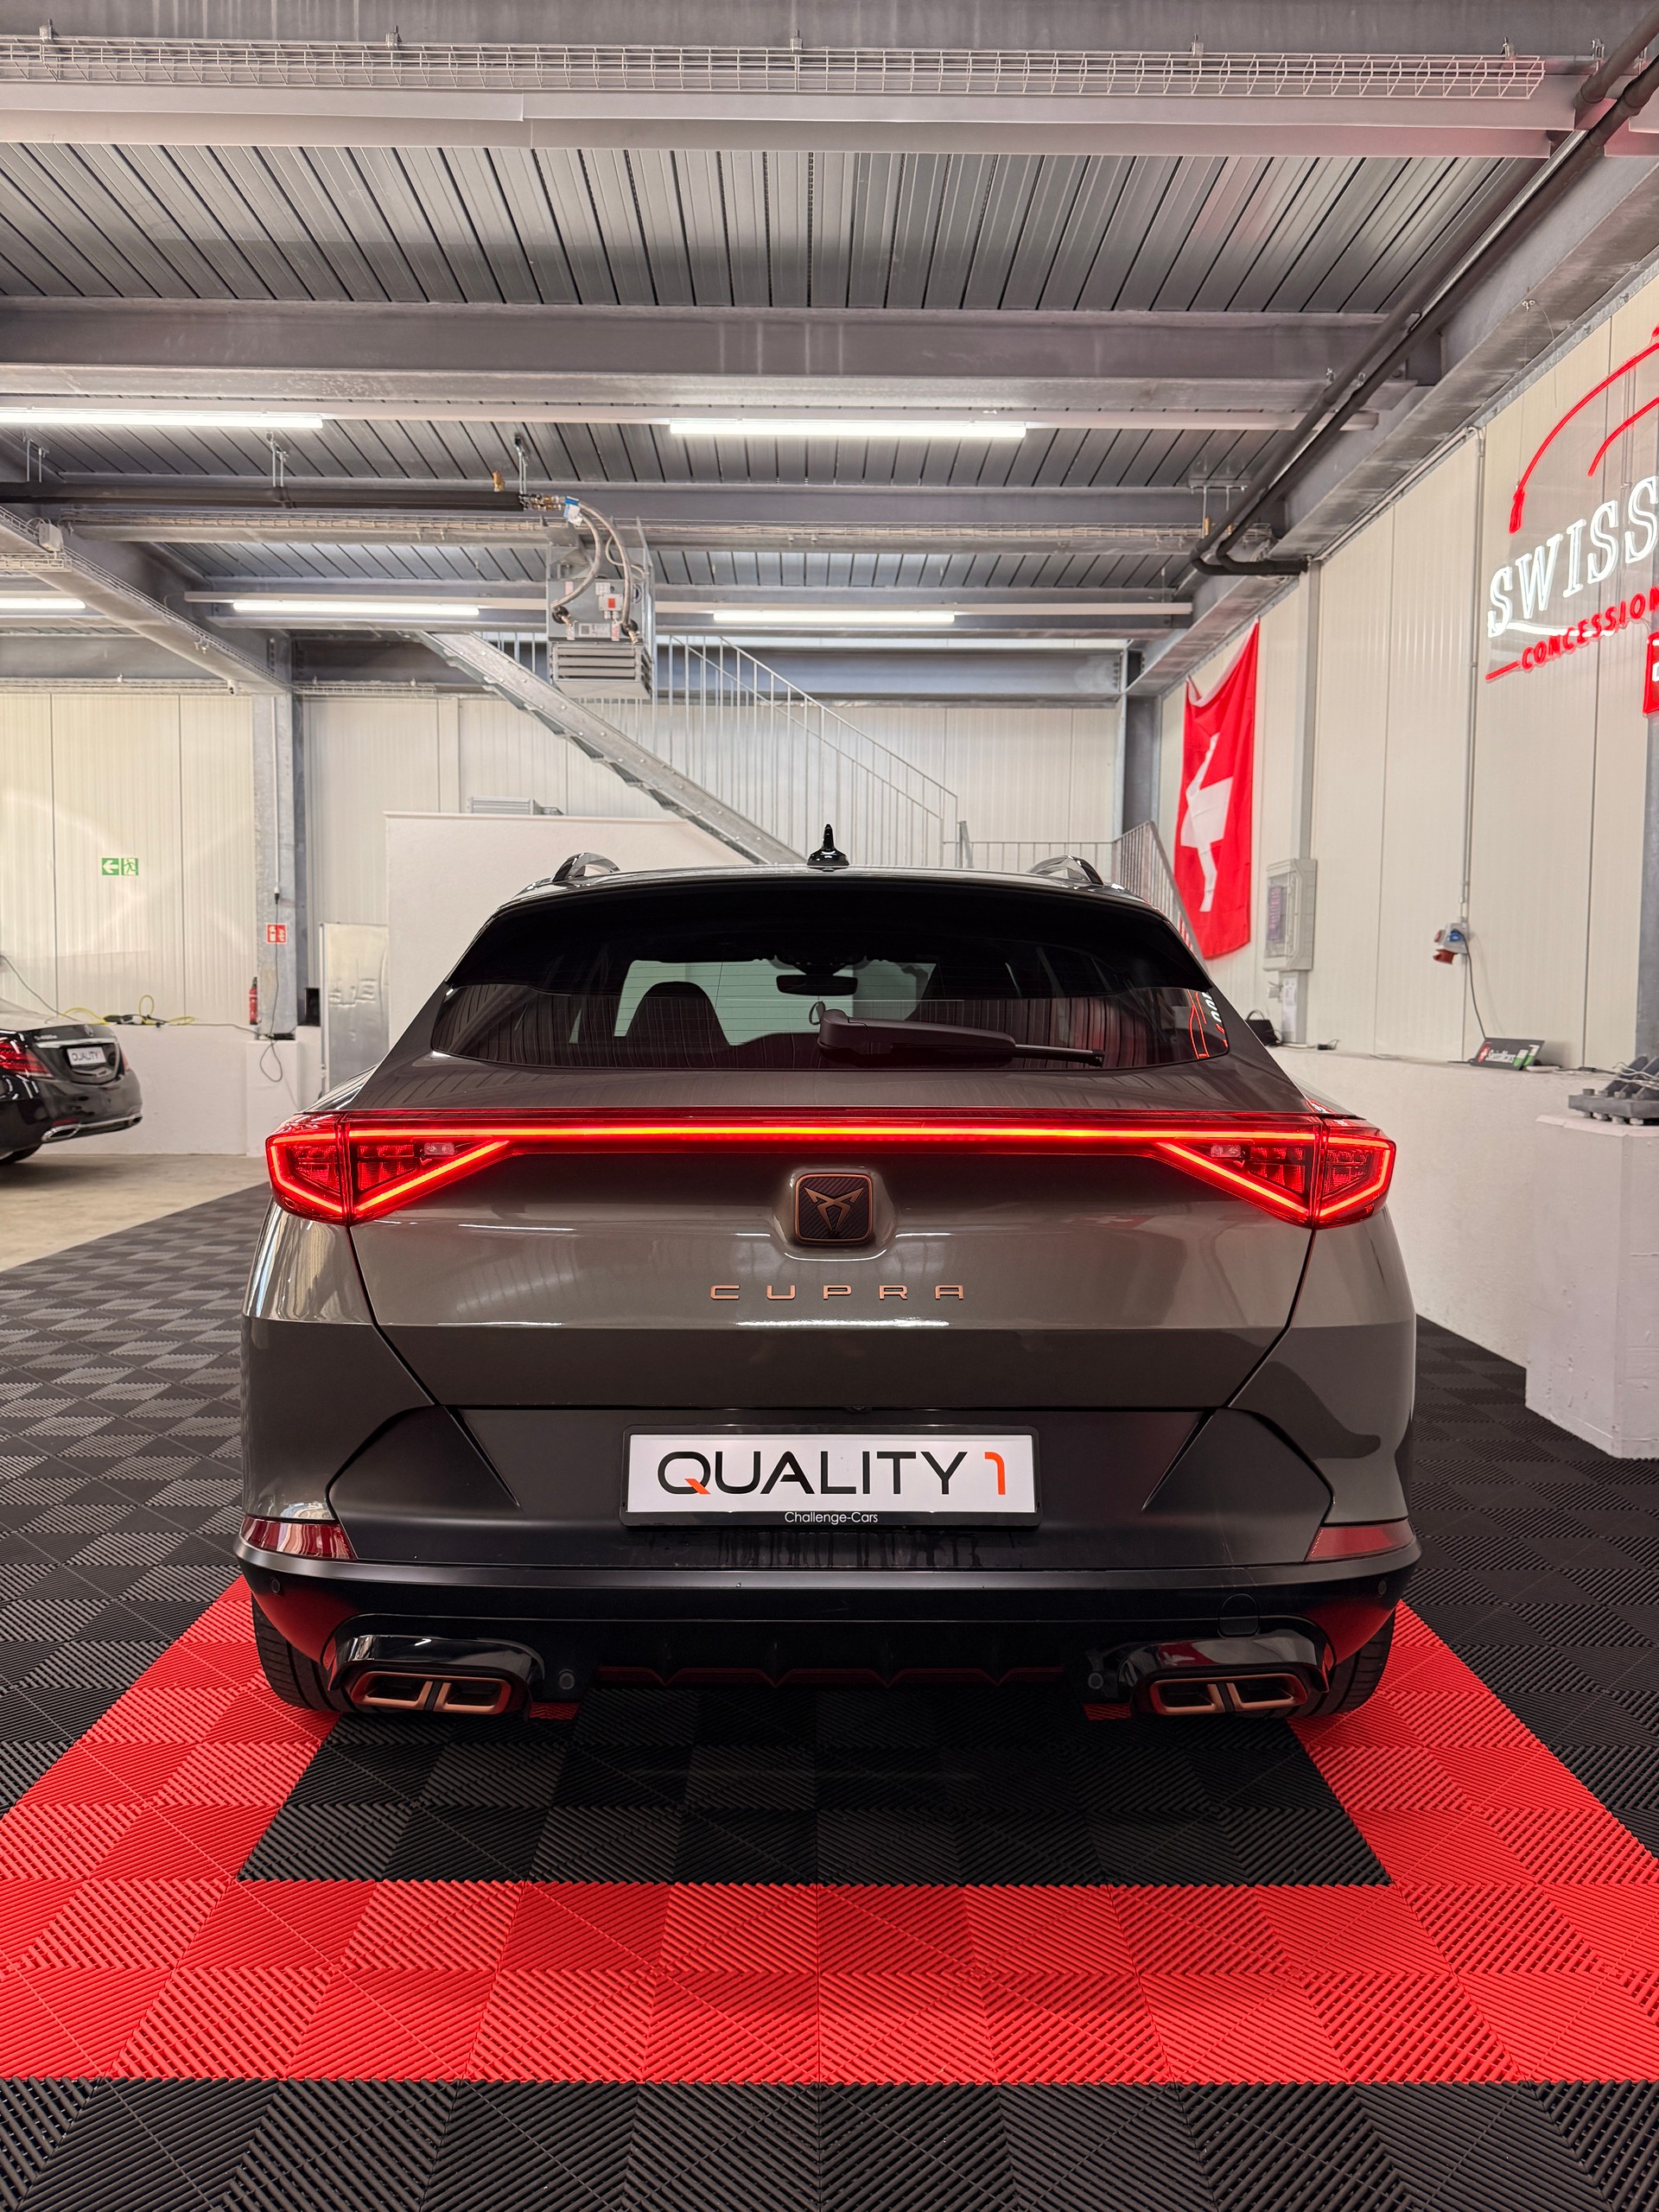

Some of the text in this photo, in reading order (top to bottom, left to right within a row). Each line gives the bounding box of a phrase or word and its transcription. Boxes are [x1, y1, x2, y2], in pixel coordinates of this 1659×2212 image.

[1487, 475, 1659, 638] SWISS
[710, 1285, 964, 1300] CUPRA
[658, 1451, 969, 1495] QUALITY
[784, 1511, 879, 1525] Challenge-Cars
